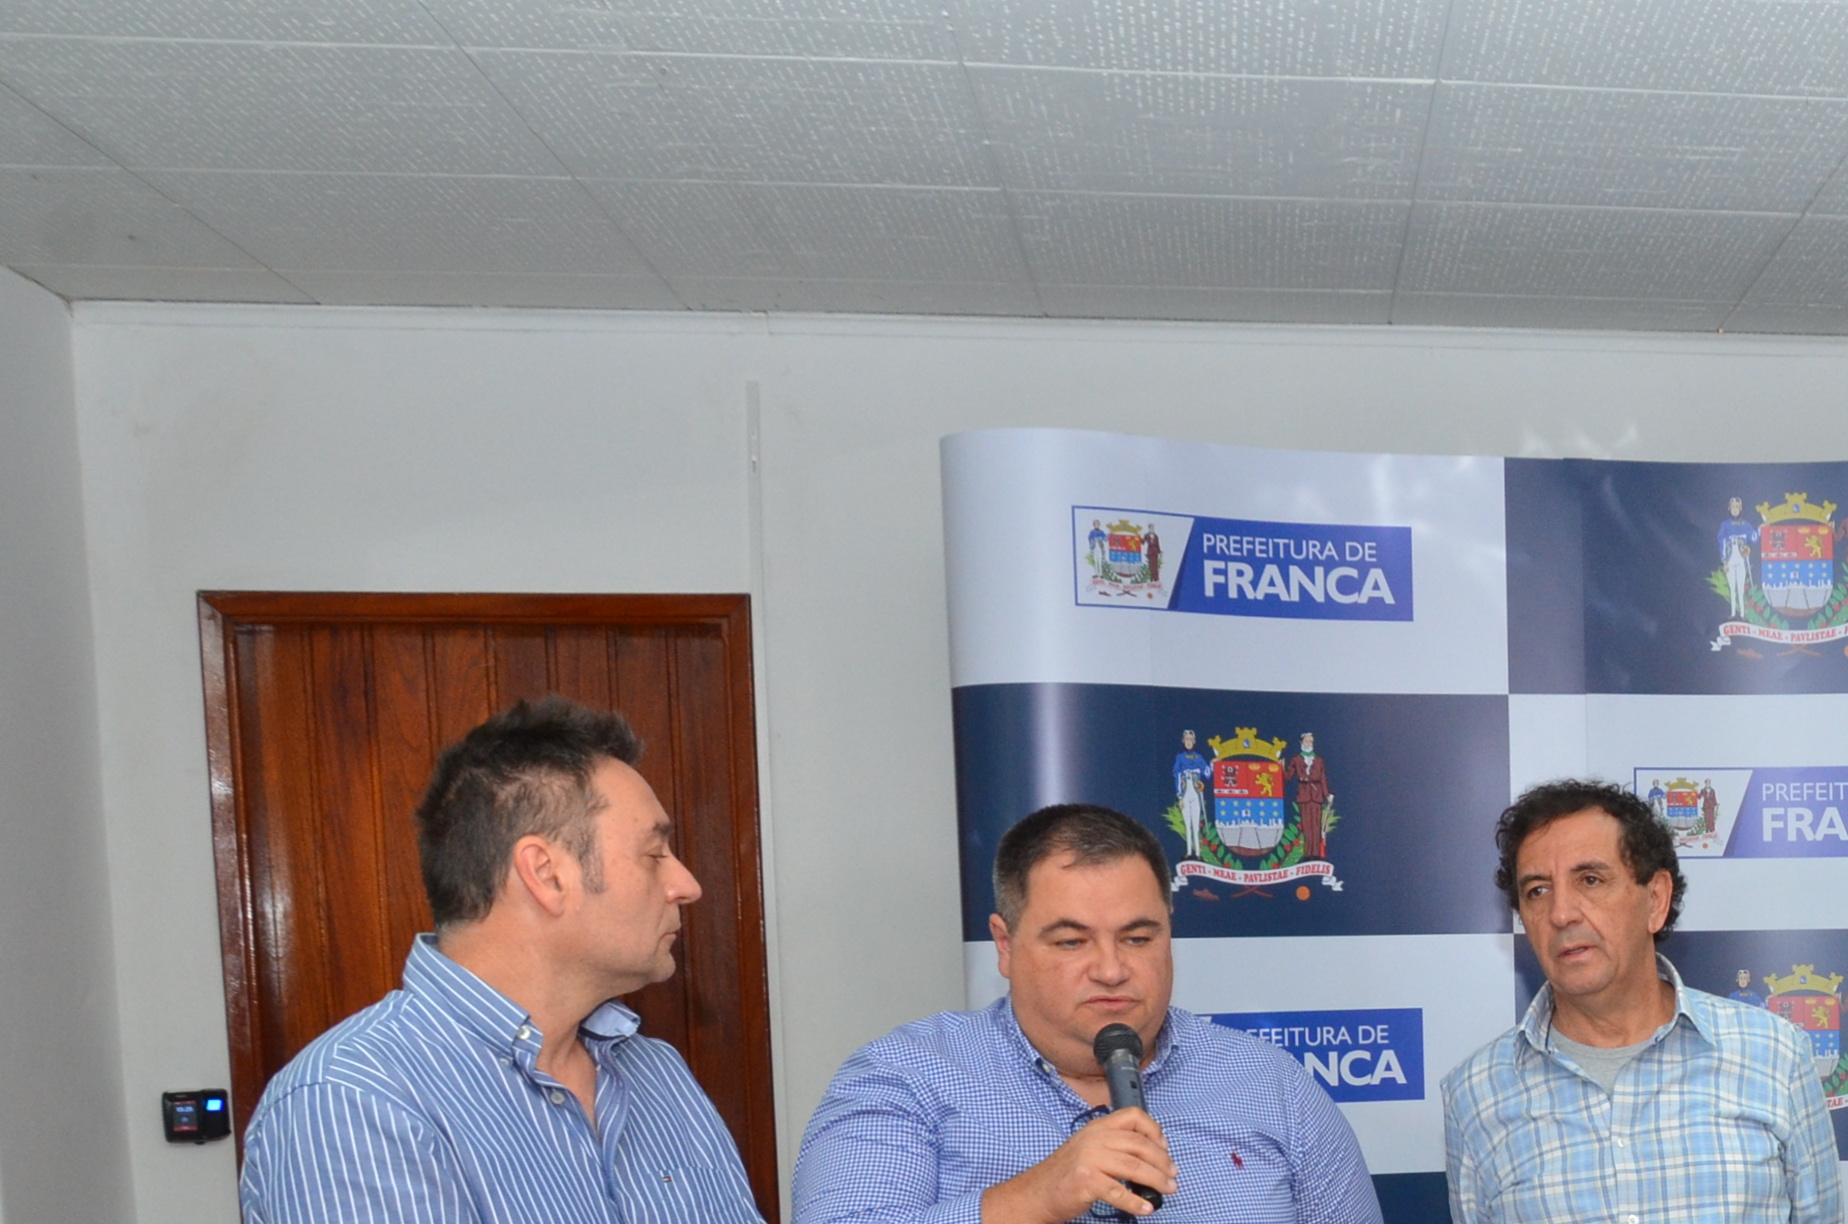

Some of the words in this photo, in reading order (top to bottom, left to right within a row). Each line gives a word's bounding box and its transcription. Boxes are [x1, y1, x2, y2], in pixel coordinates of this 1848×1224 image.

[1203, 533, 1338, 562] PREFEITURA
[1345, 541, 1377, 562] DE
[1203, 560, 1395, 605] FRANCA
[1180, 863, 1207, 876] GENTI
[1295, 863, 1332, 876] FIDELIS
[1247, 1026, 1353, 1047] FEITURA
[1358, 1025, 1389, 1044] DE
[1304, 1049, 1407, 1087] NCA
